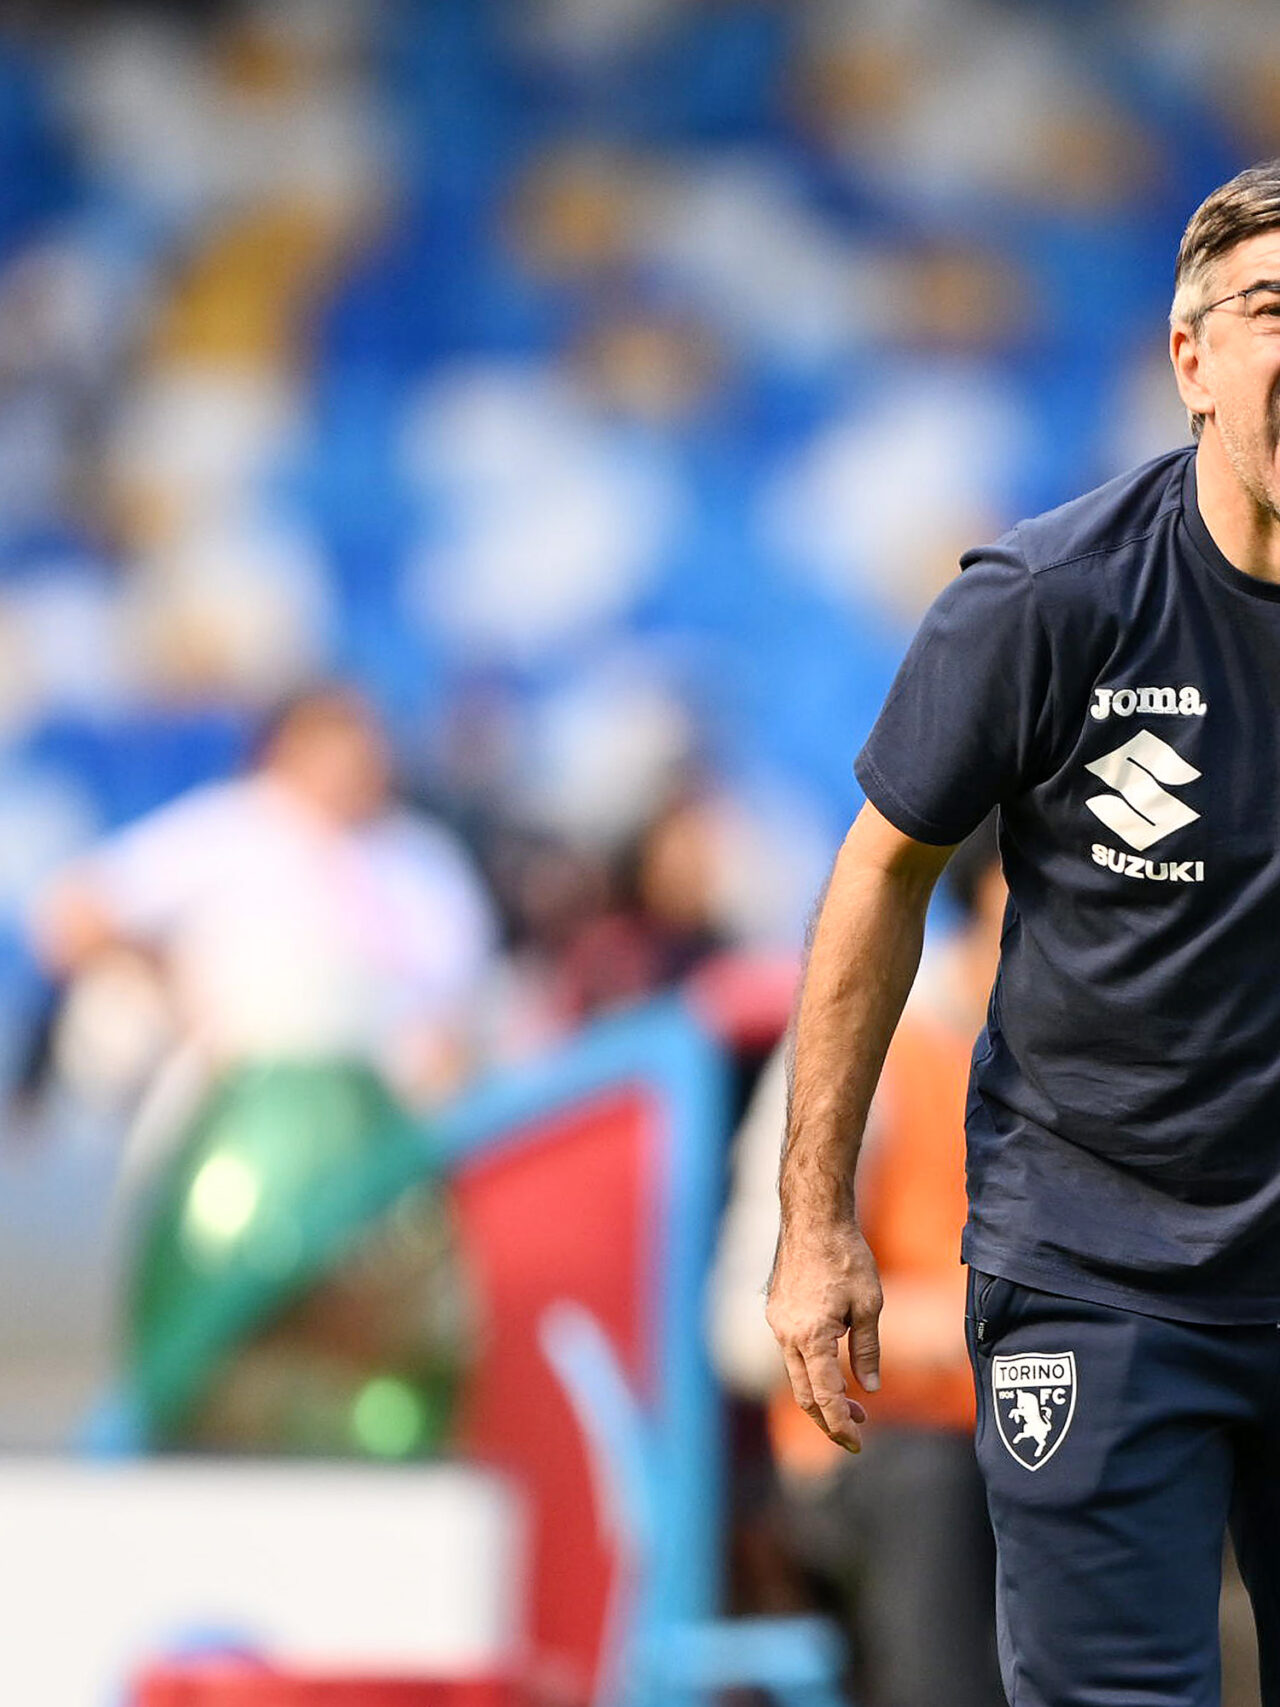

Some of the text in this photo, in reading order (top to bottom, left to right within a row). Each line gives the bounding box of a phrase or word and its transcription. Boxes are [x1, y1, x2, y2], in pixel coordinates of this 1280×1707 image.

[1090, 686, 1207, 720] Joma
[1091, 843, 1204, 882] SUZUKI
[999, 1364, 1064, 1382] TORINO
[1040, 1388, 1066, 1406] FC
